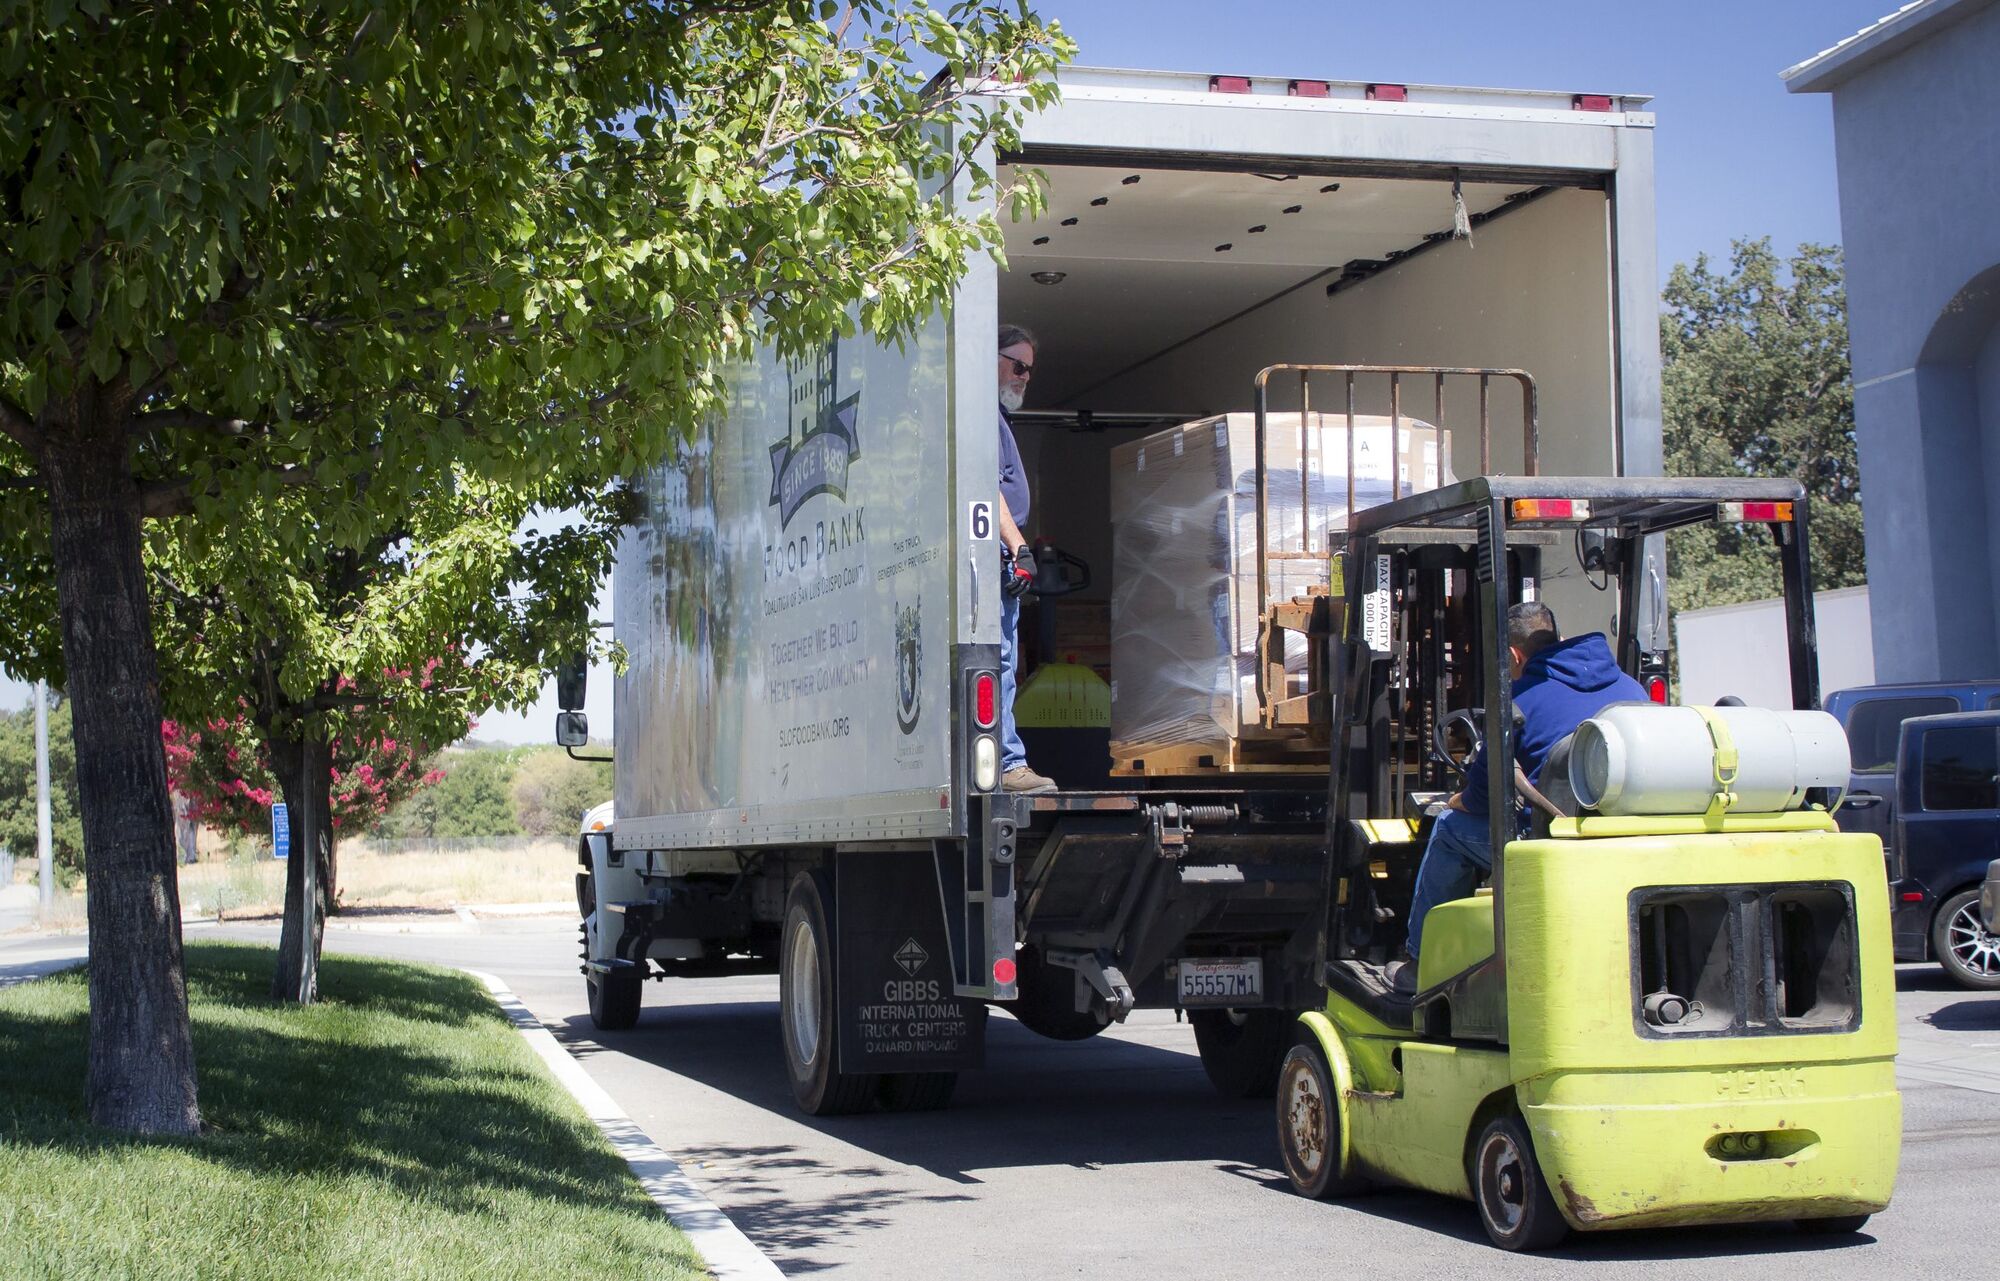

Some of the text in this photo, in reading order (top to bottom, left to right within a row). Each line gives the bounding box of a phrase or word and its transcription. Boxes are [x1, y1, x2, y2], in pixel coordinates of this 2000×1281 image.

[784, 446, 844, 503] SINCE 1989
[972, 502, 990, 539] 6
[764, 506, 865, 582] FOOD BANK
[843, 563, 865, 587] COUNTY
[1379, 557, 1389, 648] MAX CAPACITY
[771, 619, 858, 667] TOGETHER WE BUILD
[1366, 626, 1375, 643] lbs
[770, 675, 815, 704] HEALTHIER
[816, 657, 870, 693] COMMUNITY
[779, 716, 850, 748] SLOFOODBANK.ORG
[1194, 963, 1246, 974] California
[884, 980, 940, 1002] GIBBS
[1184, 974, 1257, 996] 55557M1
[859, 1003, 964, 1021] INTERNATIONAL
[858, 1021, 967, 1038] TRUCK CENTERS
